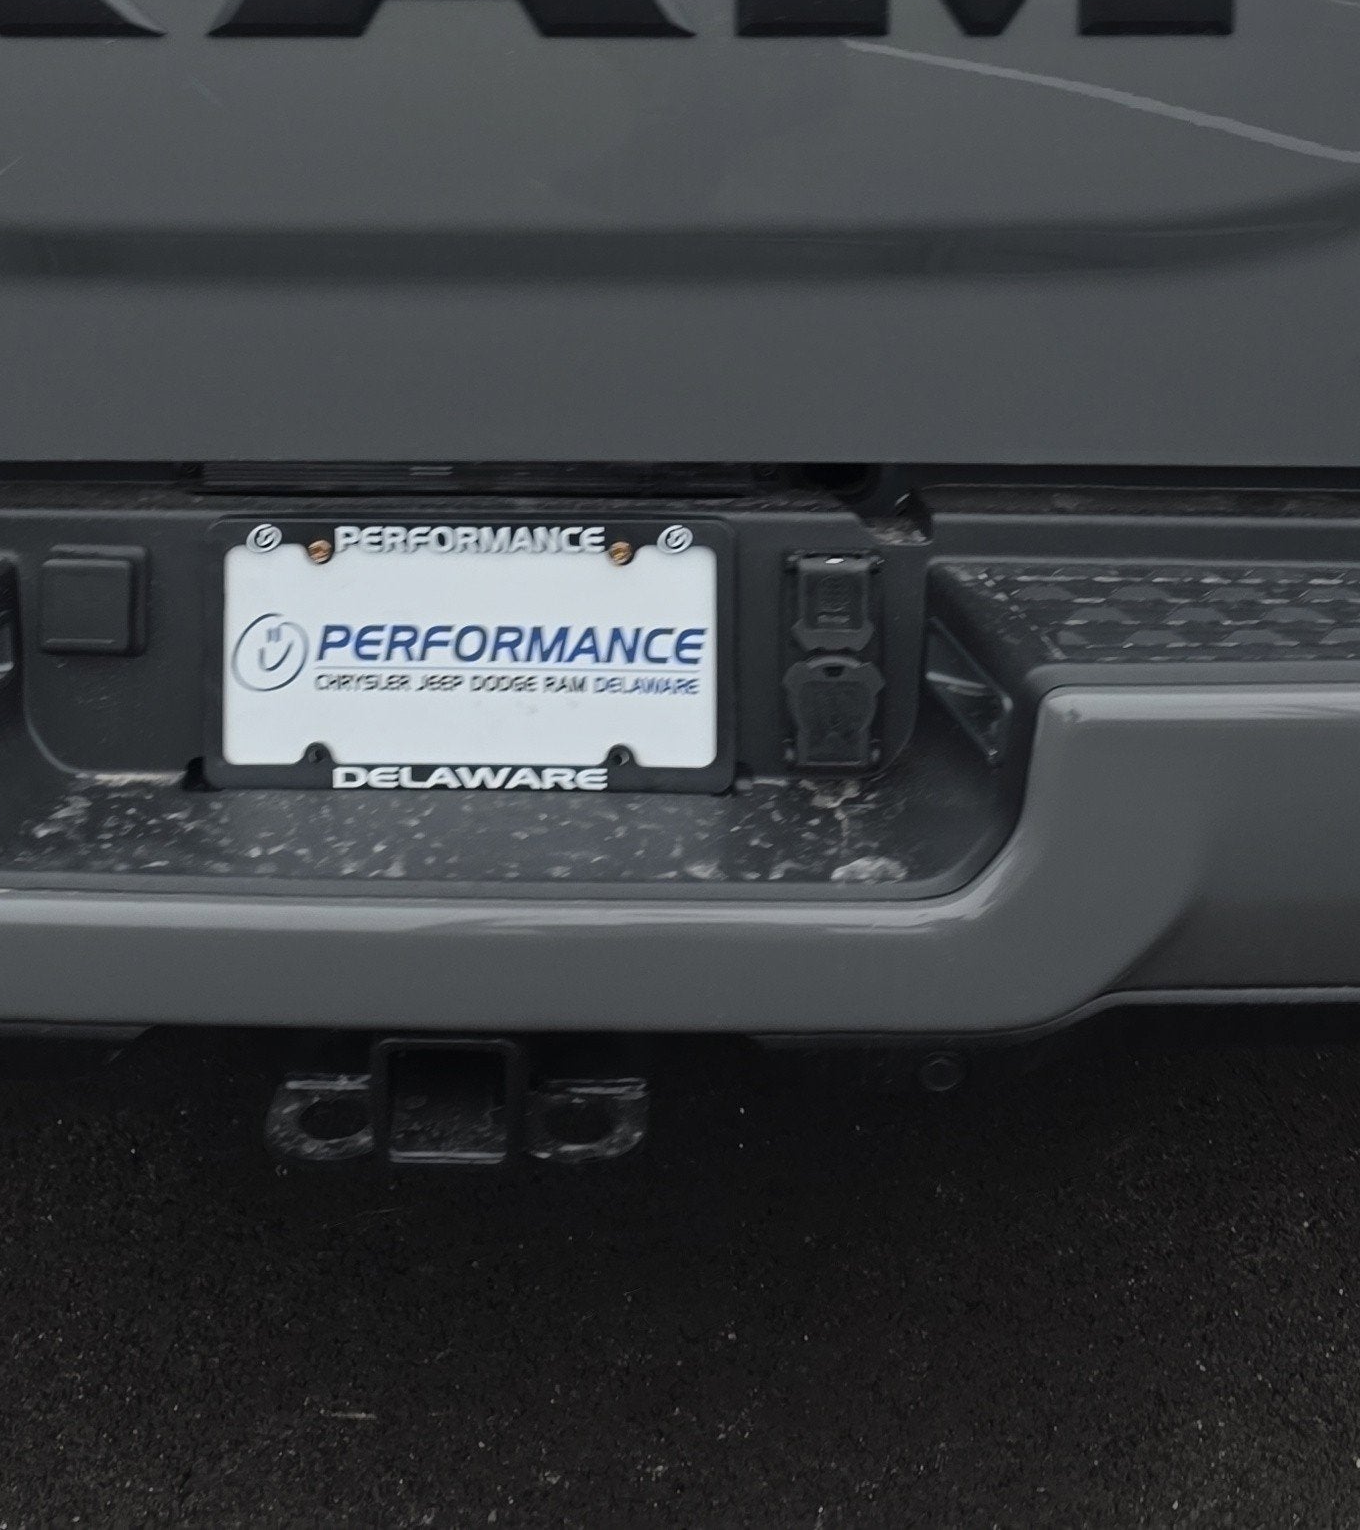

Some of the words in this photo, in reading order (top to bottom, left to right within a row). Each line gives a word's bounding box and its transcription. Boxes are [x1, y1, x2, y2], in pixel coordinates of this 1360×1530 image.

[334, 525, 607, 554] PERFORMANCE
[316, 624, 709, 665] PERFORMANCE
[315, 673, 411, 691] CHRYSLER
[416, 674, 464, 691] JEEP
[470, 674, 537, 692] DODGE
[543, 675, 587, 693] RAM
[594, 677, 700, 695] DELAWARE
[332, 766, 609, 791] DELAWARE
